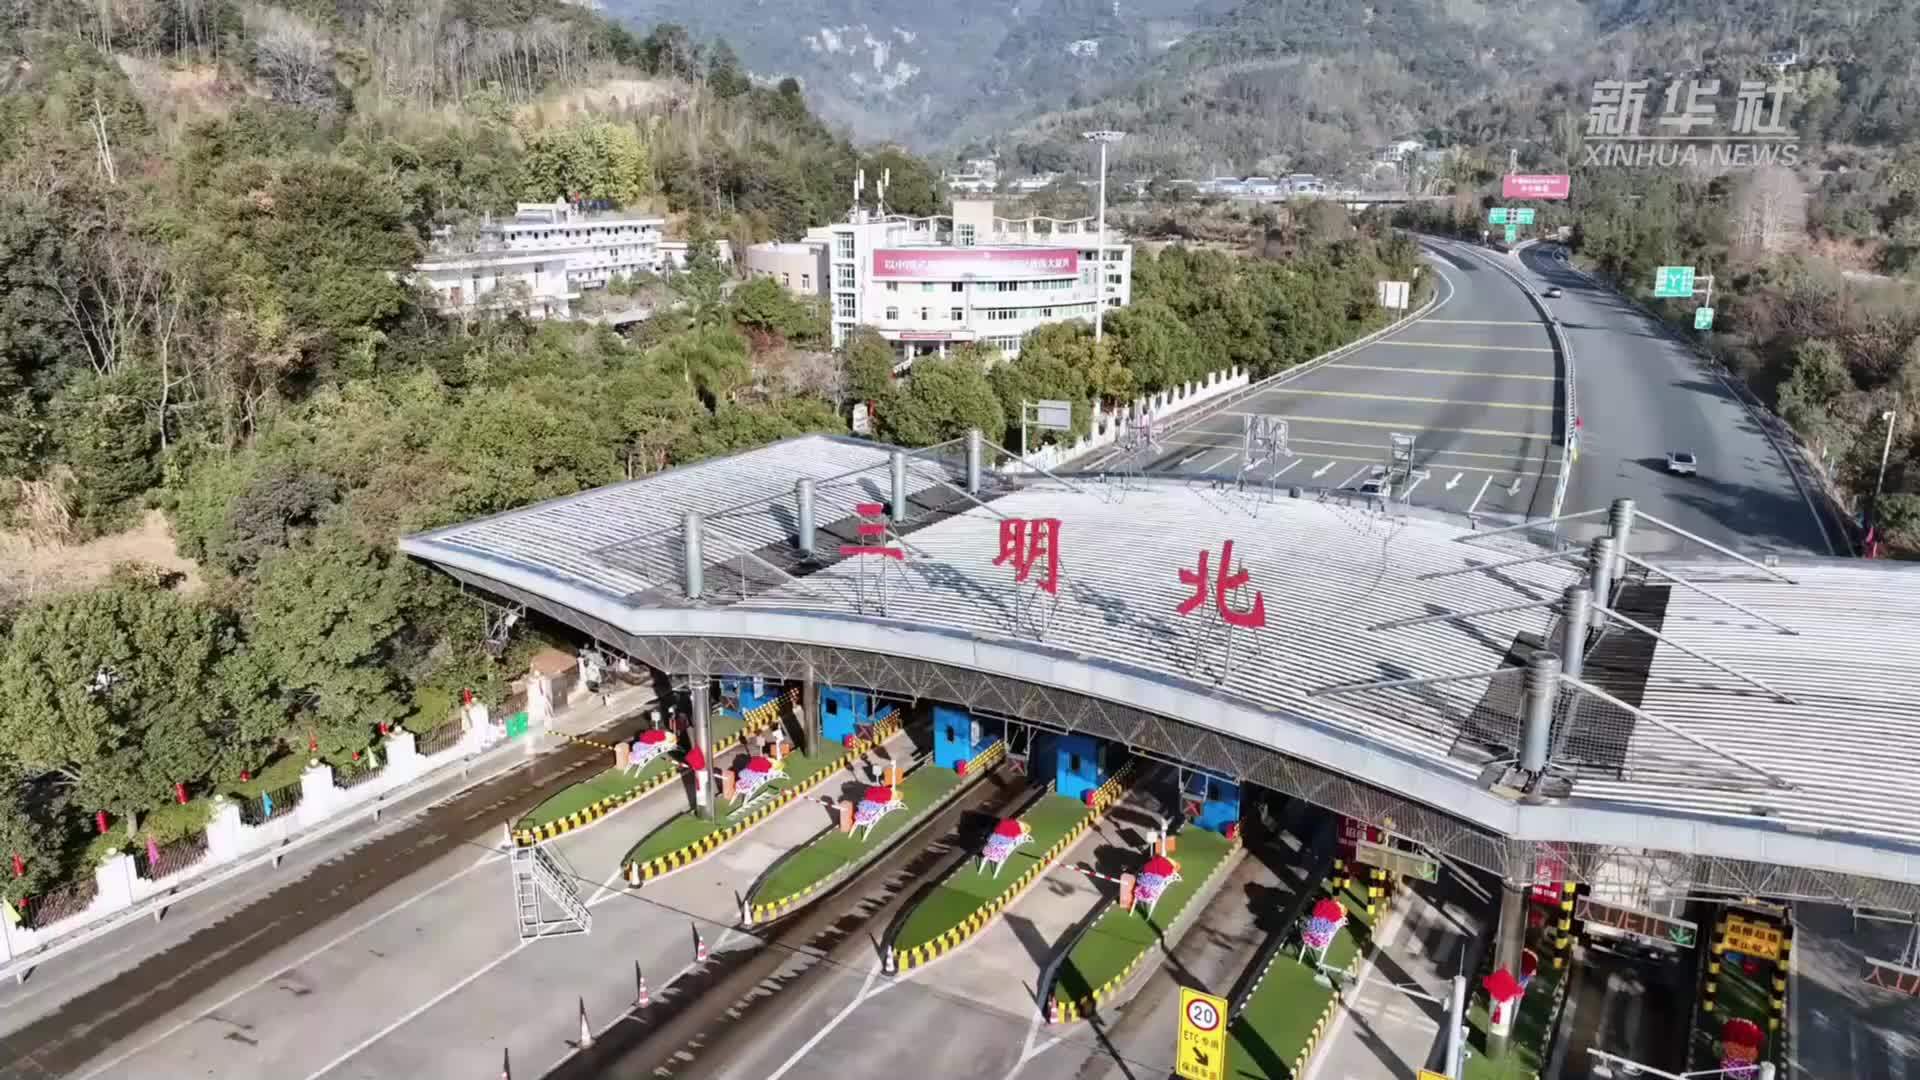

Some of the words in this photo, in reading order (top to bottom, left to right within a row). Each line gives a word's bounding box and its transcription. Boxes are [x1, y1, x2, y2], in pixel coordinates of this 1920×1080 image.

[839, 501, 1265, 627] 三明北
[1194, 1005, 1212, 1023] 20
